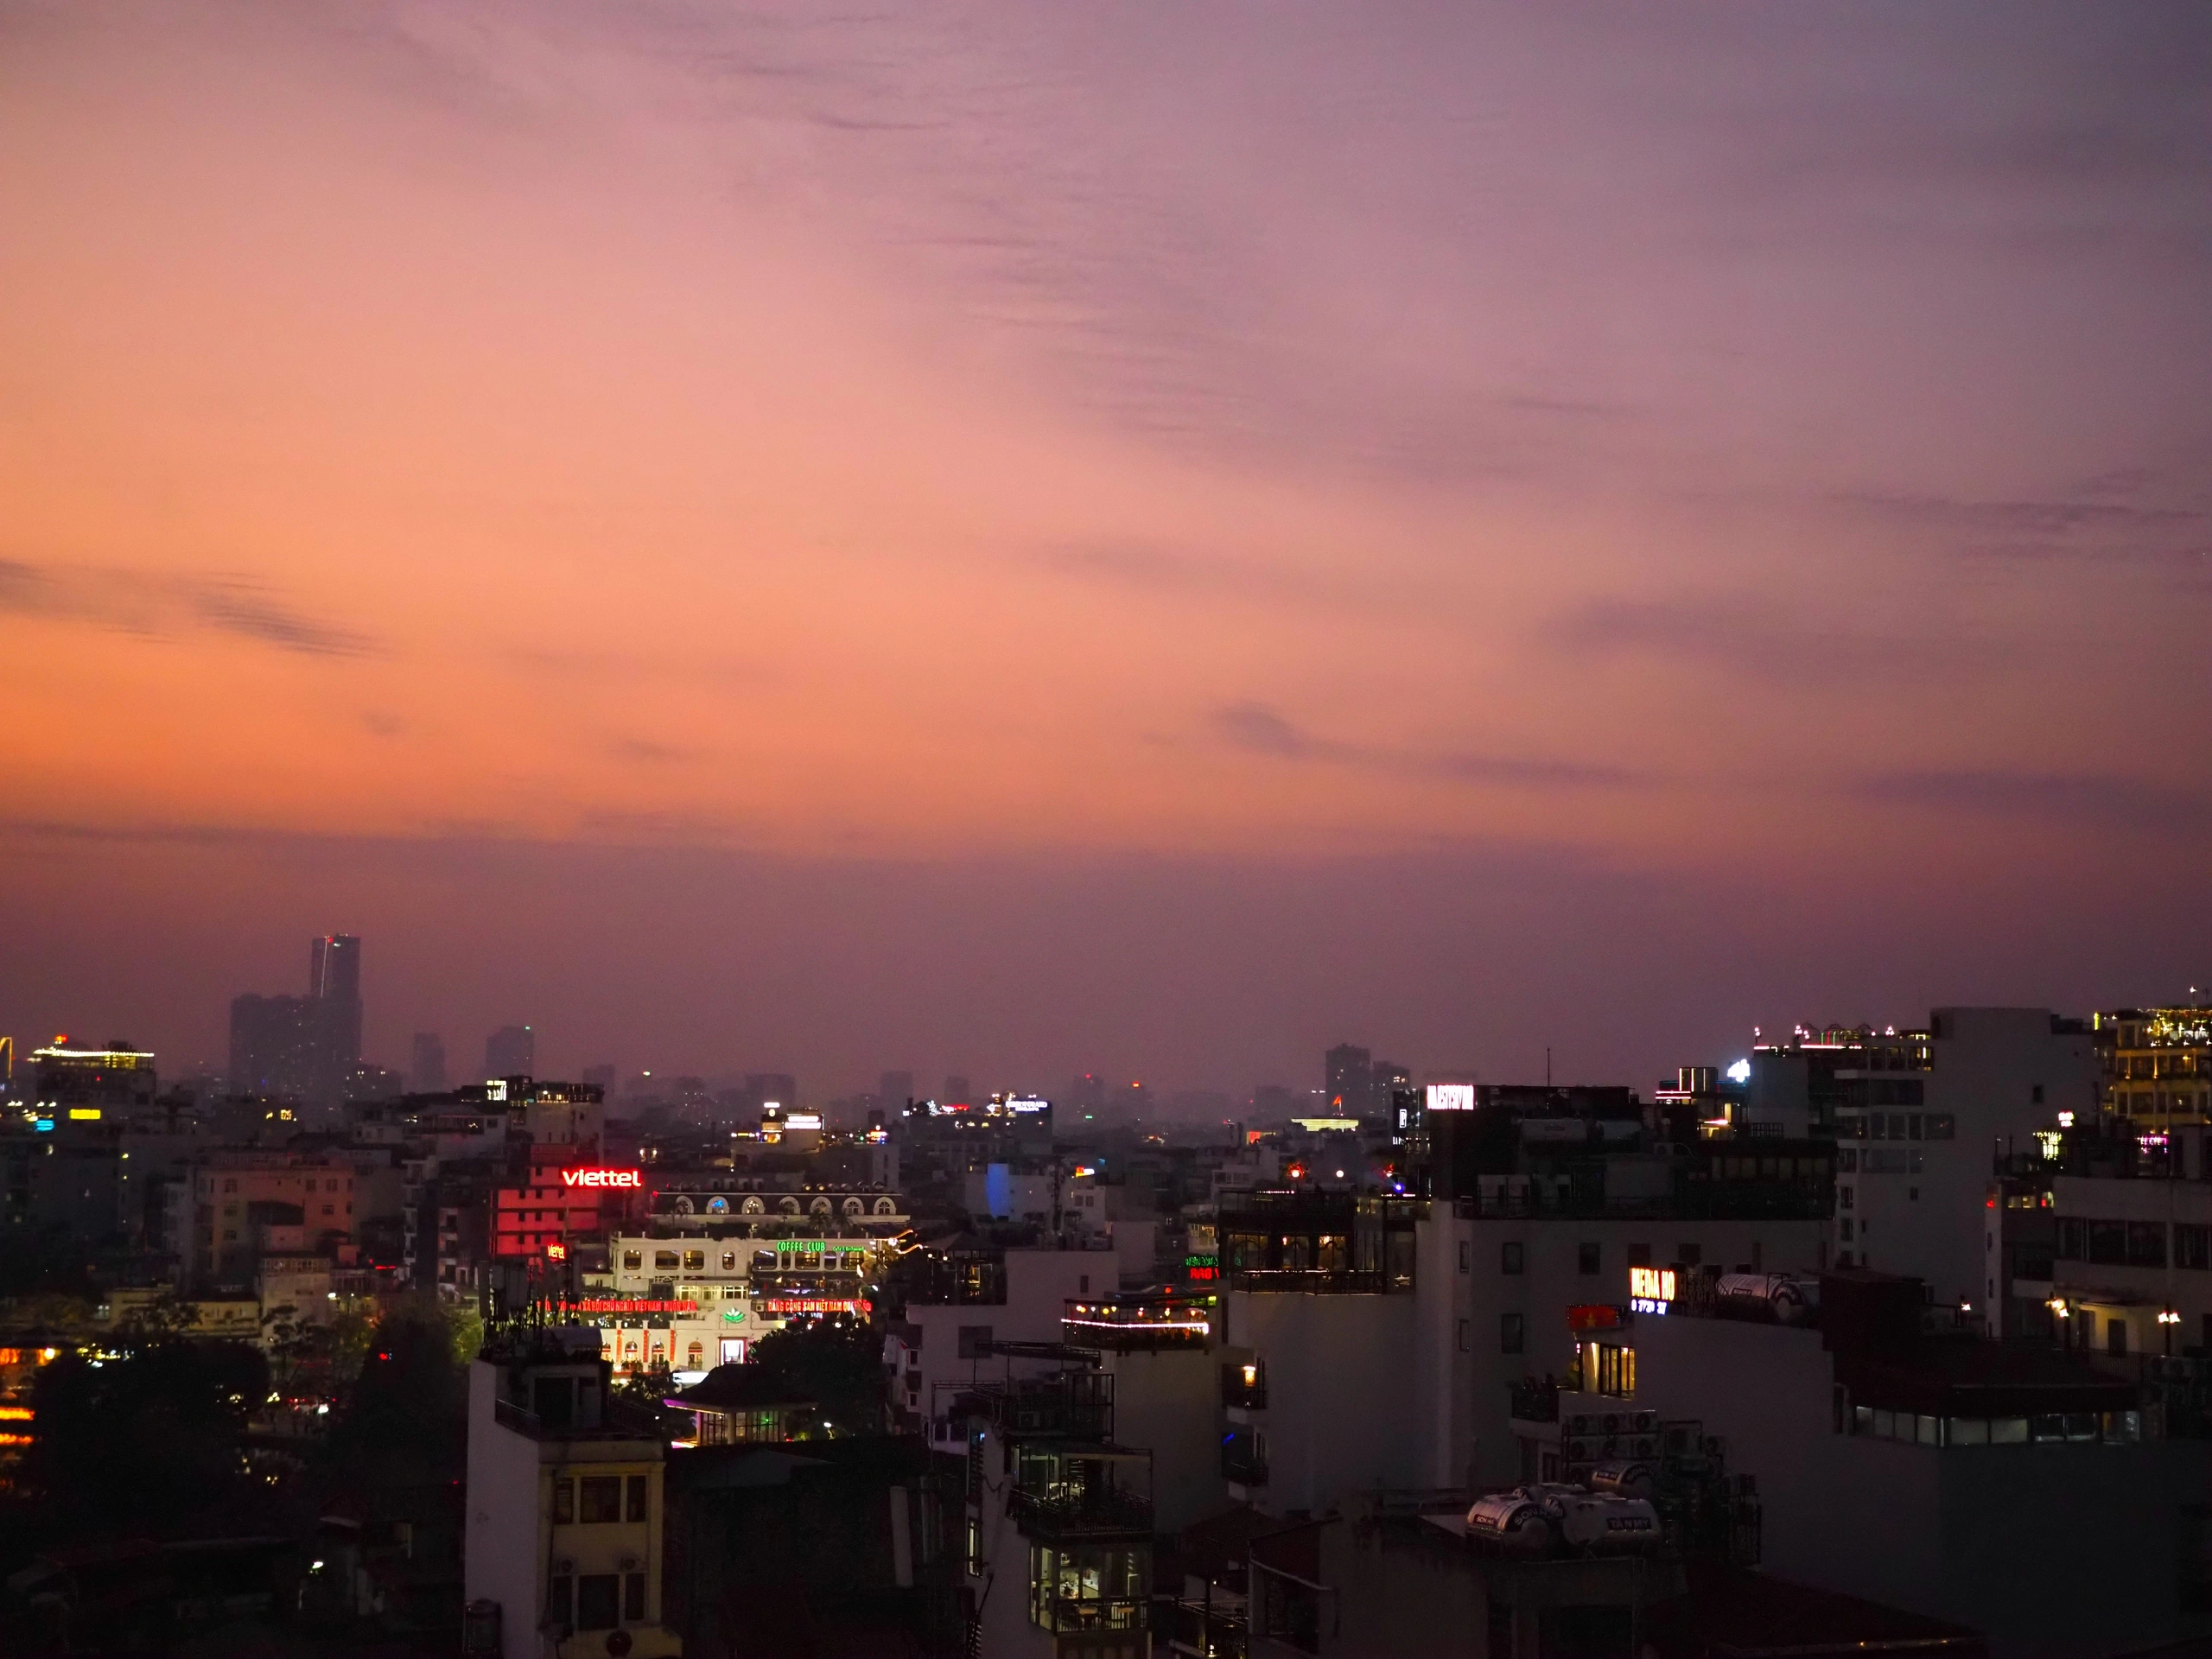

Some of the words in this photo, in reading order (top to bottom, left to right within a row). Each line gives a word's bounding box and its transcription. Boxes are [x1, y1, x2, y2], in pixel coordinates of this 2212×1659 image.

[563, 1169, 641, 1186] viettel
[778, 1242, 804, 1251] COFFEE
[807, 1242, 825, 1251] CLUB
